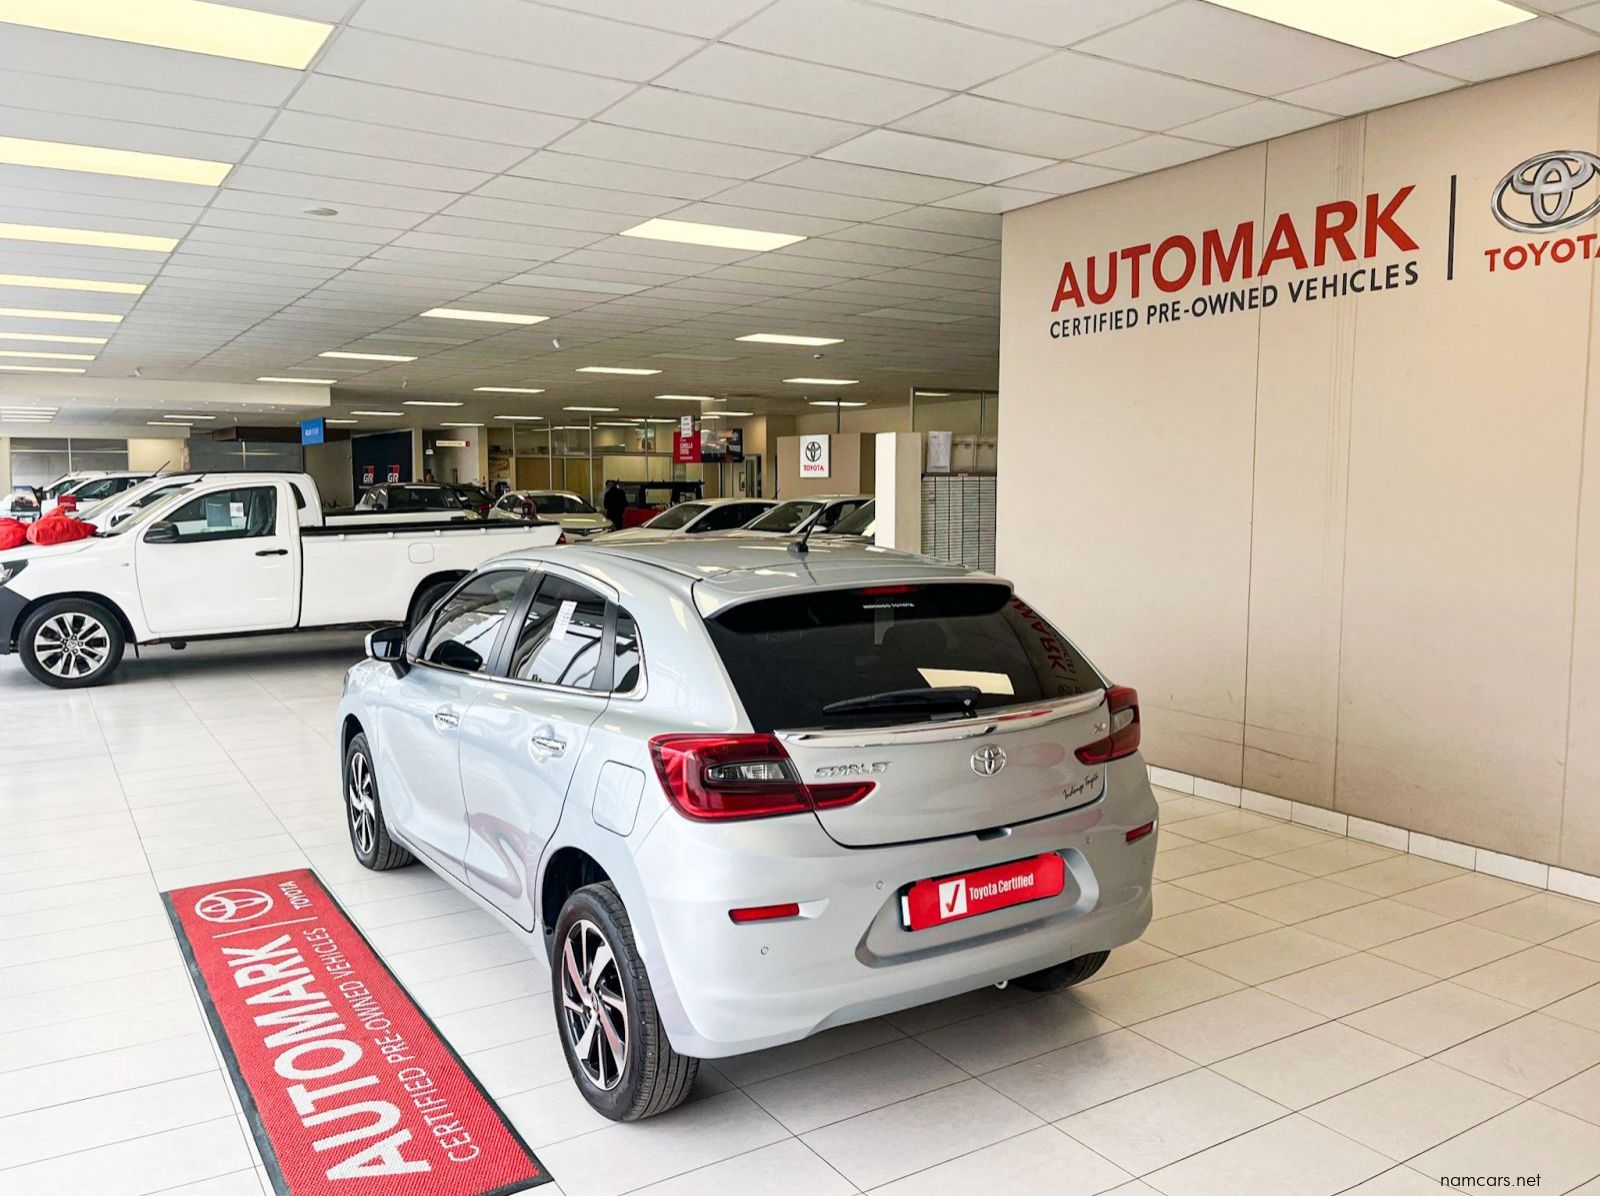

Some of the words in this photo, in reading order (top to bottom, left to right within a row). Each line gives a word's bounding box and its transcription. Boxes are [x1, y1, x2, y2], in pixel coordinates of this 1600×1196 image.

[1051, 184, 1420, 313] AUTOMARK
[1484, 233, 1600, 272] TOYOT
[1050, 308, 1139, 339] CERTIFIED
[1146, 284, 1278, 325] PRE-OWNED
[1288, 261, 1419, 302] VEHICLES
[387, 472, 399, 483] GR
[278, 881, 313, 910] TOYOTA
[969, 884, 998, 901] Toyota
[998, 873, 1034, 893] Certified
[303, 927, 355, 985] VEHICLES
[339, 980, 415, 1063] PRE-OWNED
[221, 934, 432, 1181] AUTOMARK
[398, 1066, 479, 1163] CERTIFIED
